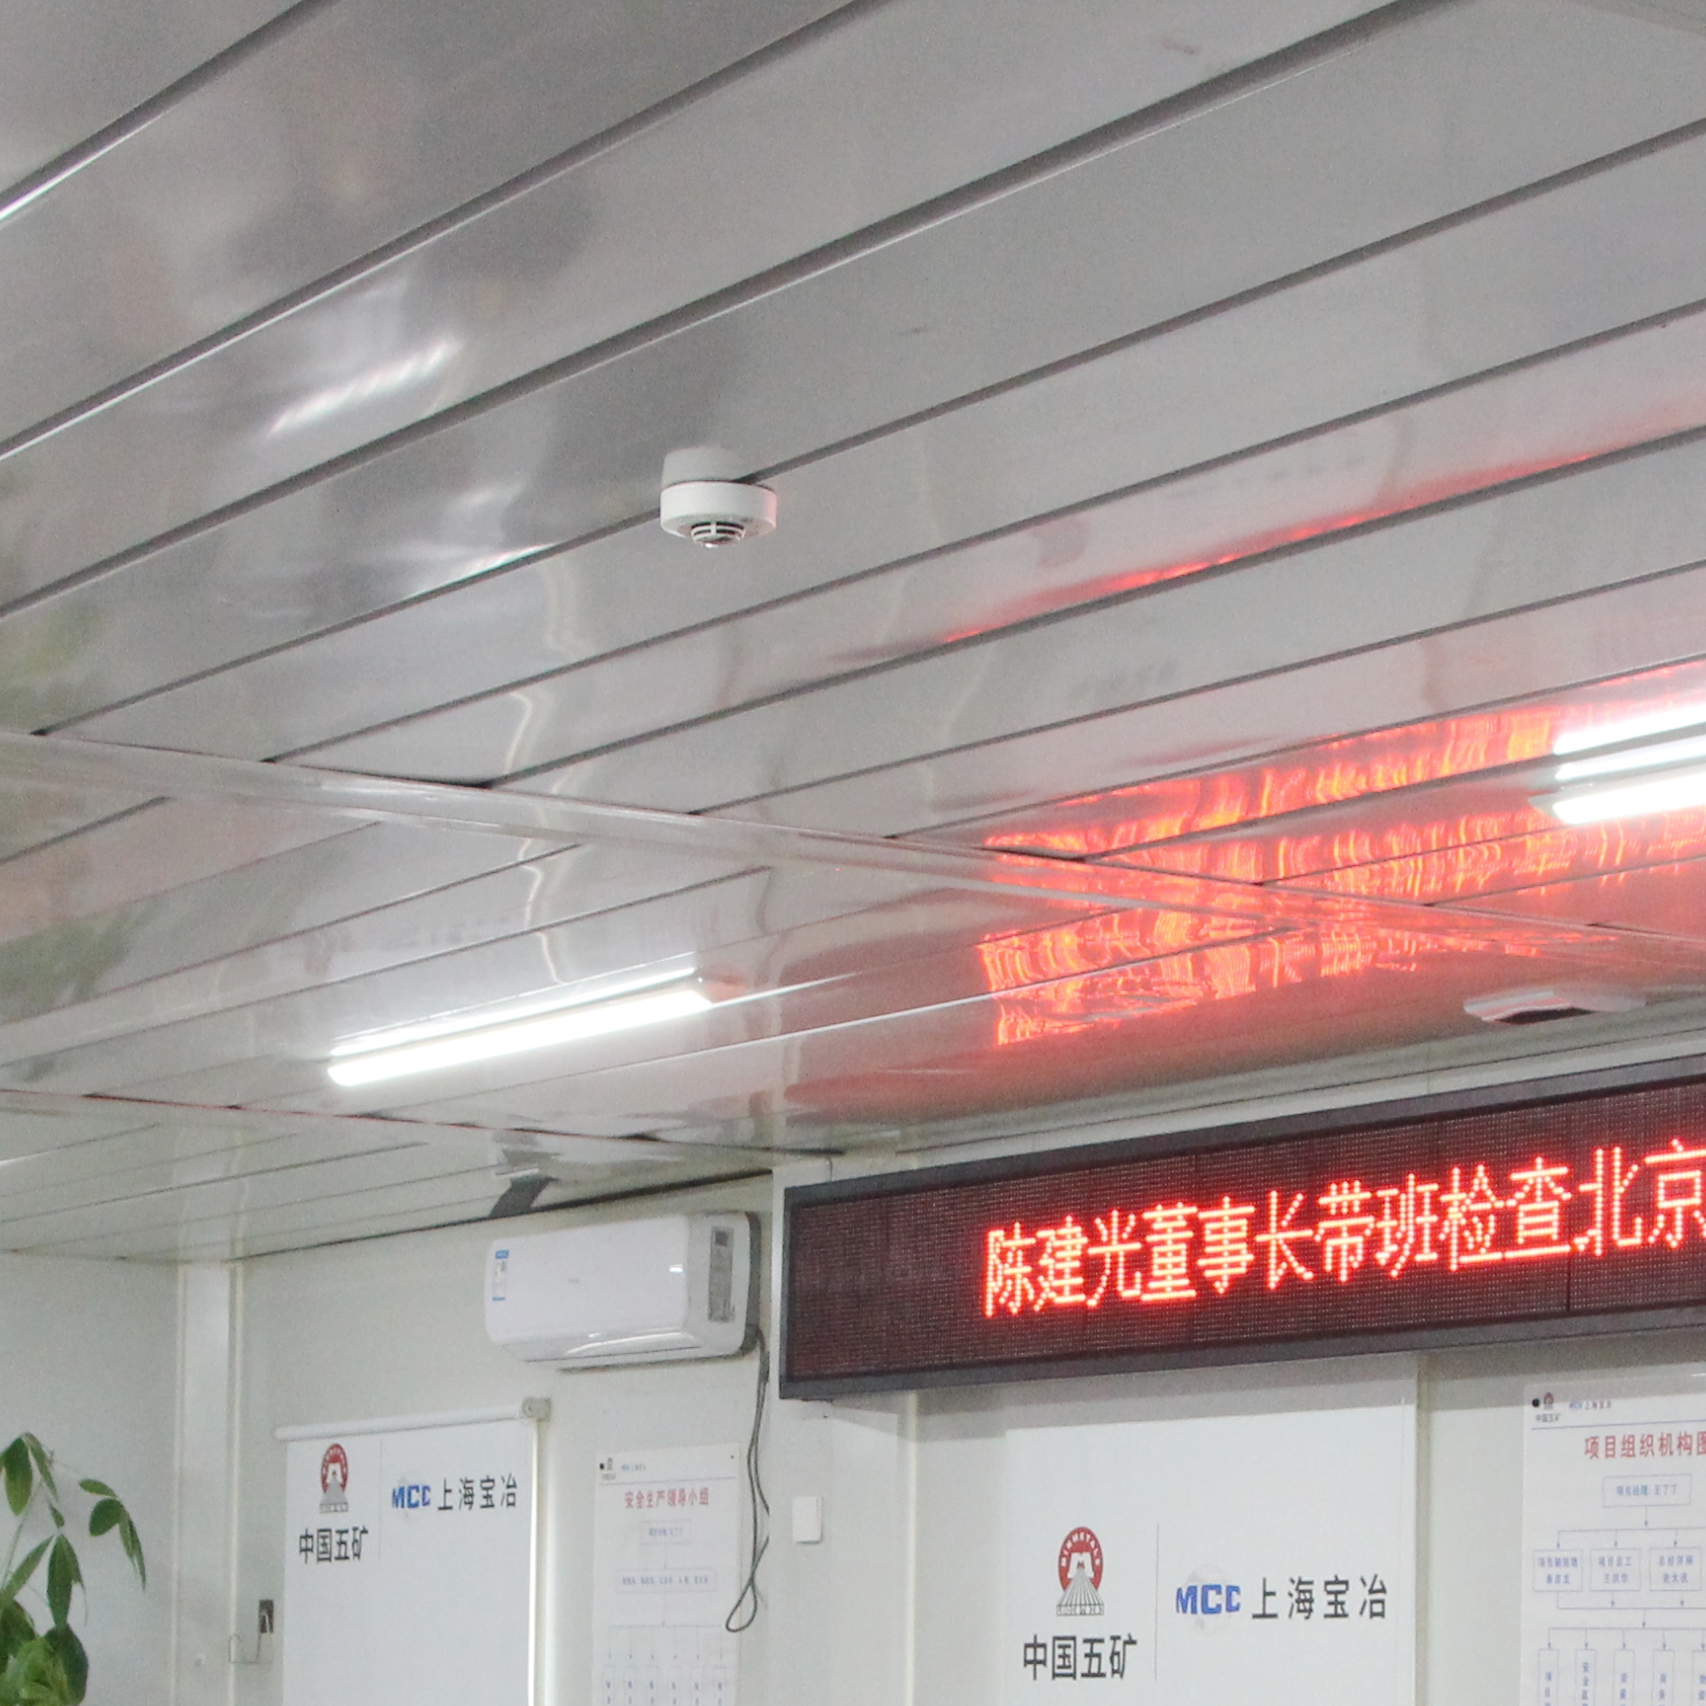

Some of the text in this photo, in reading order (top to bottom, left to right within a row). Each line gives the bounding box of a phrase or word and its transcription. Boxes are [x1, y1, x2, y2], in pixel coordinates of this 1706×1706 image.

[391, 1473, 517, 1511] MCC 上海宝冶
[298, 1524, 369, 1564] 中国五矿
[1175, 1574, 1388, 1620] MCC 上海宝冶
[1023, 1633, 1137, 1681] 中国五矿
